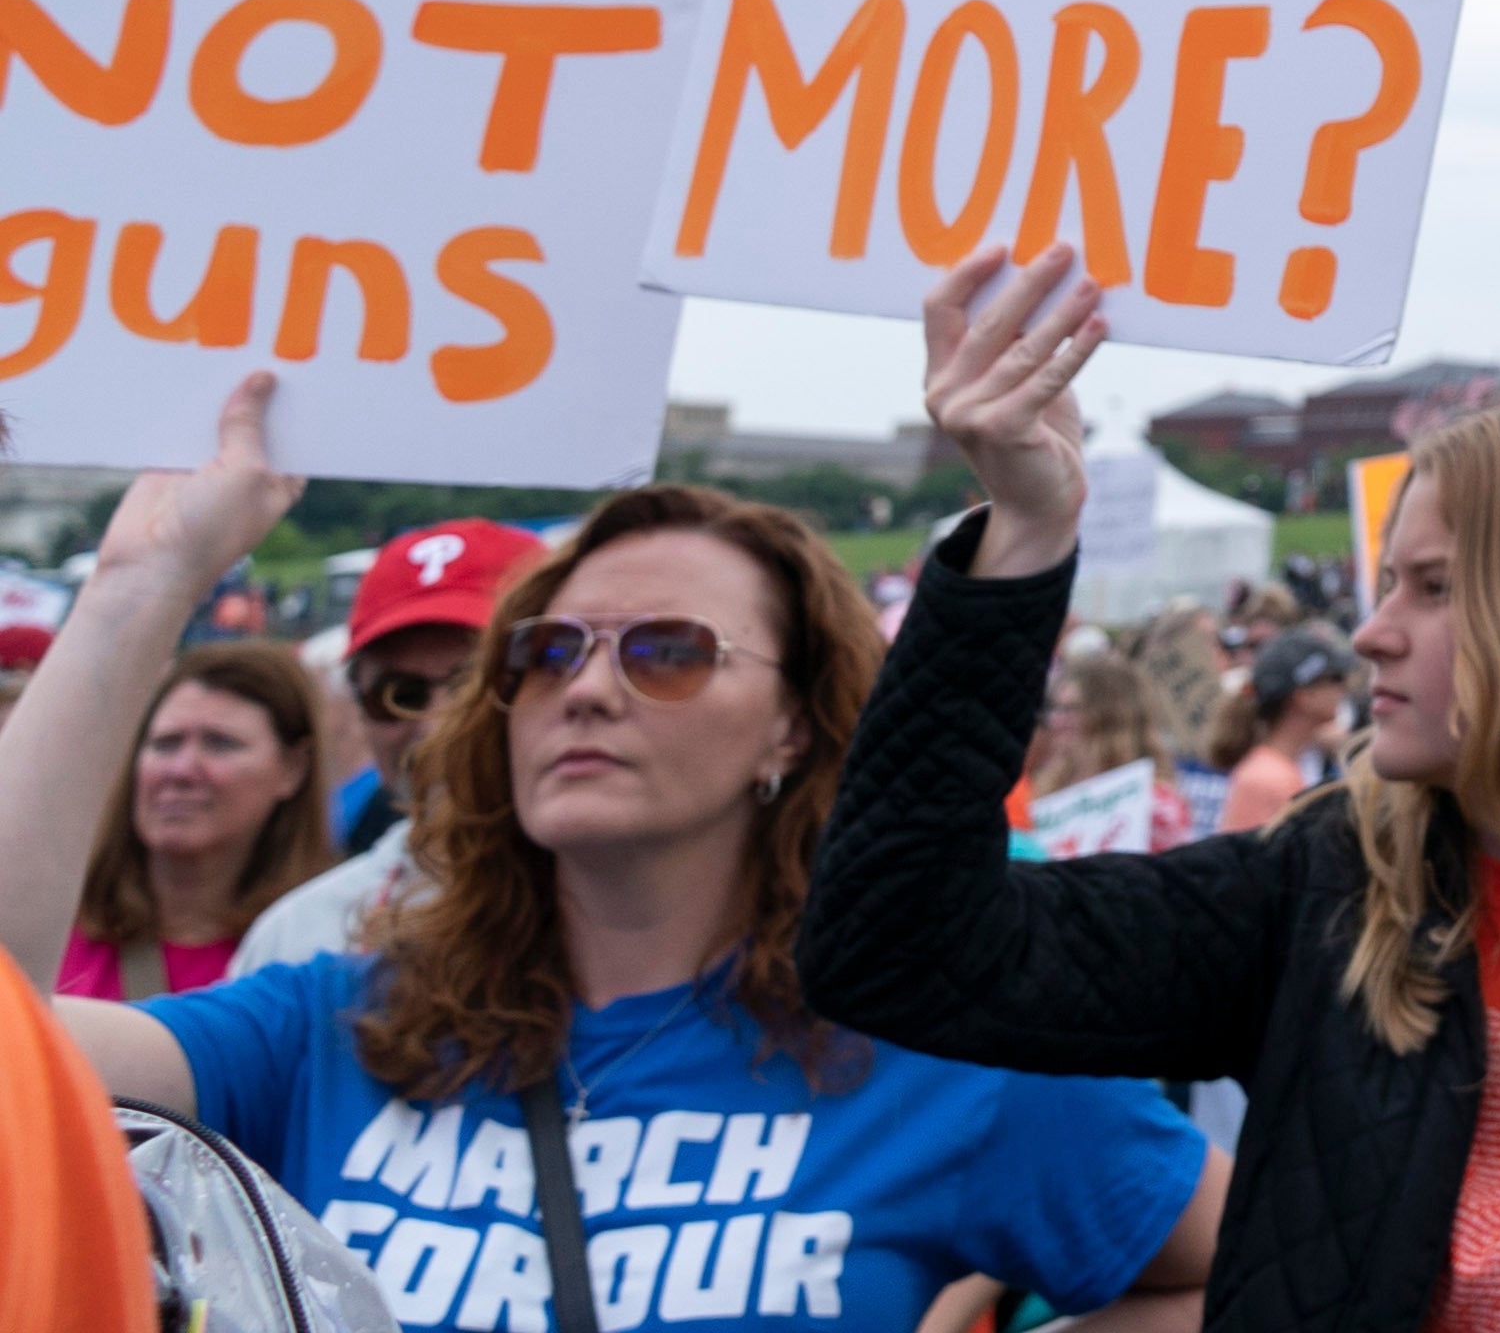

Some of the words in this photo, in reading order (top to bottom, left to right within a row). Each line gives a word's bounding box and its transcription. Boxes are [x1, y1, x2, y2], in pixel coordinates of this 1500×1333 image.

[0, 209, 556, 403] guns
[340, 1099, 812, 1219] MARCH
[585, 1210, 853, 1333] OUR
